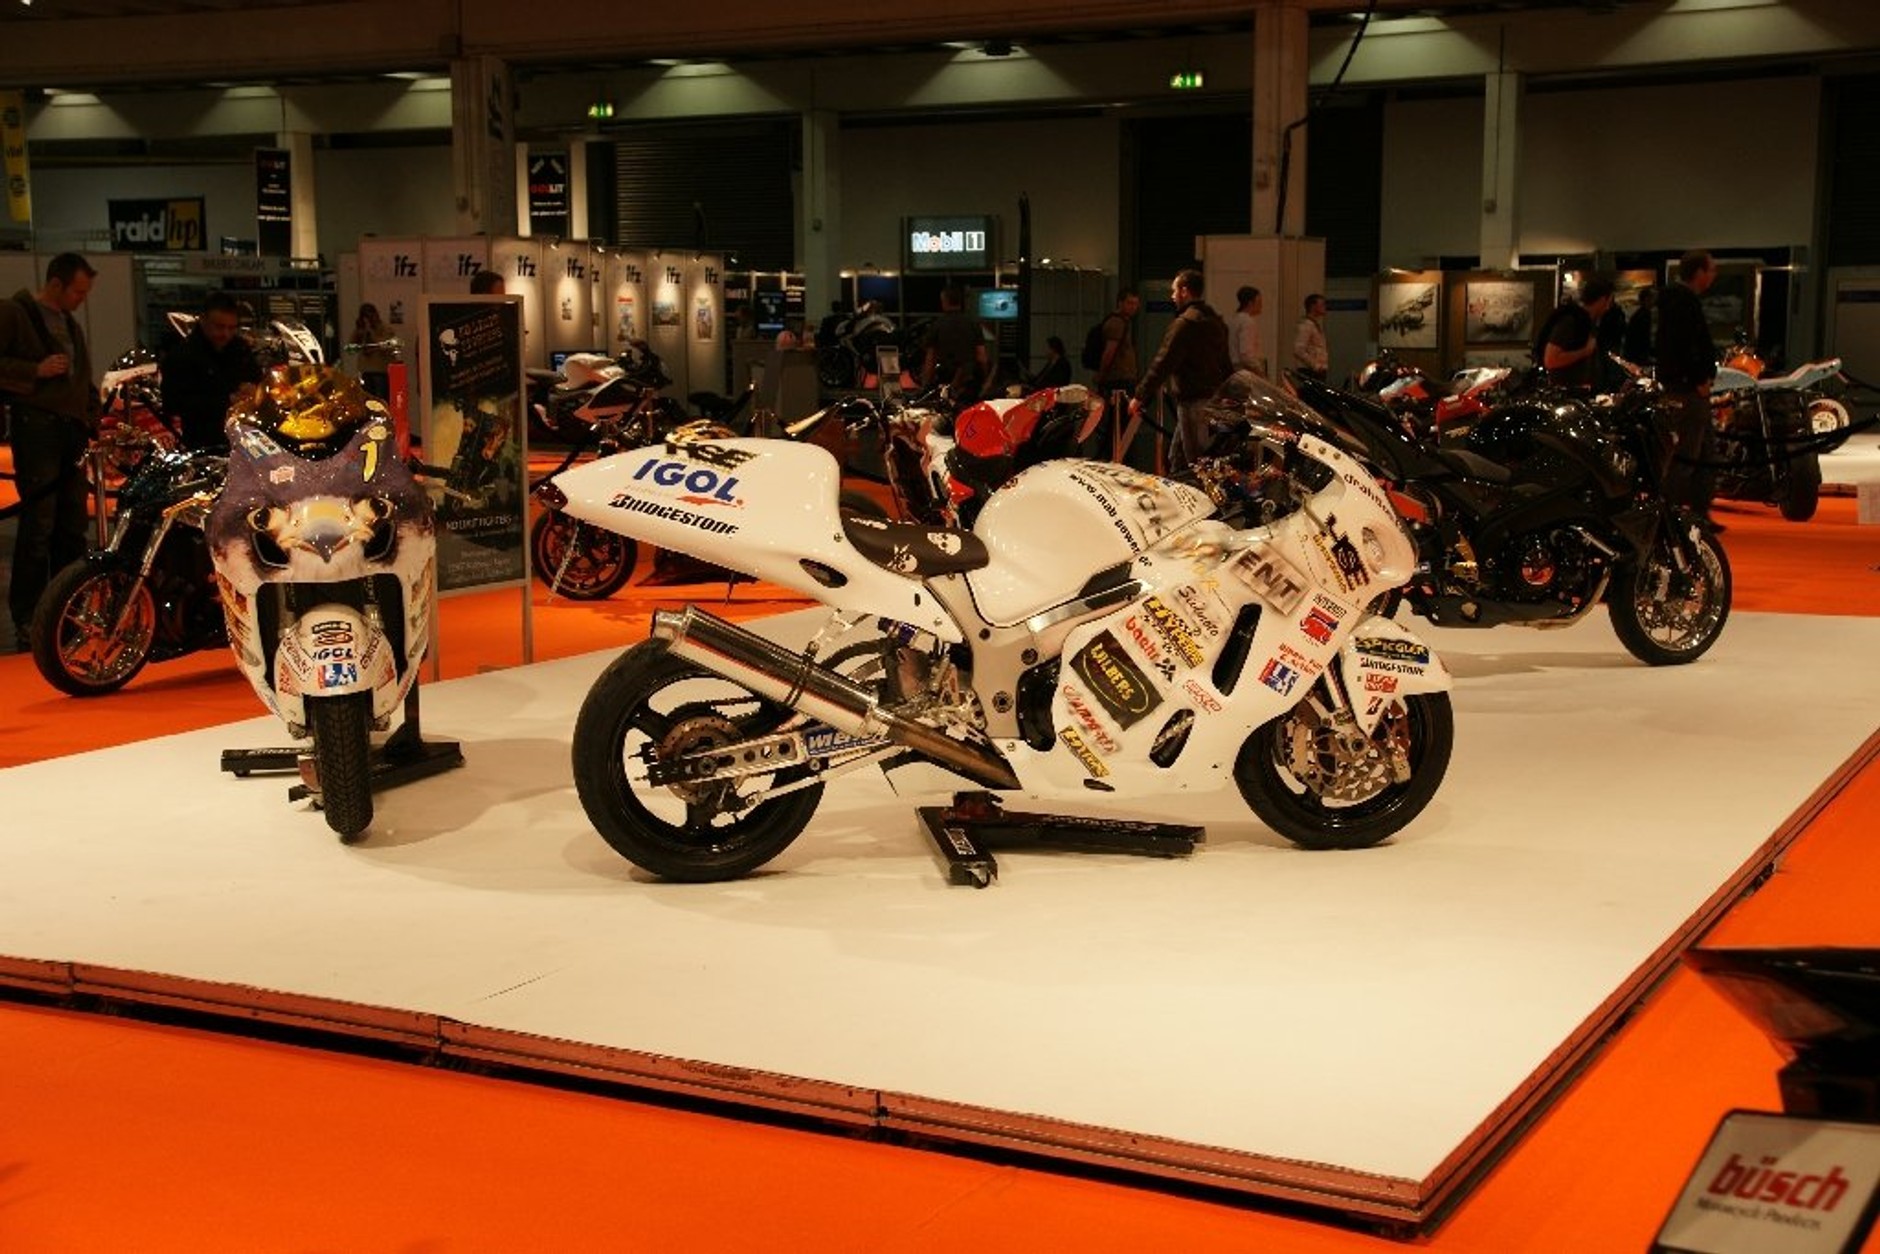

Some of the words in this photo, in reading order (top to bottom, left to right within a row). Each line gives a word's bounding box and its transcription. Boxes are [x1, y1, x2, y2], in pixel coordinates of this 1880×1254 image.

[911, 231, 963, 253] Mobil
[394, 255, 418, 277] ifz
[458, 254, 482, 277] ifz
[517, 255, 536, 277] ifz
[567, 257, 585, 279] ifz
[632, 458, 740, 503] IGOL
[608, 493, 739, 536] BRIDGESTONE
[1125, 615, 1161, 661] baehr
[1090, 642, 1135, 700] WILBERS
[1708, 1153, 1851, 1213] büsch
